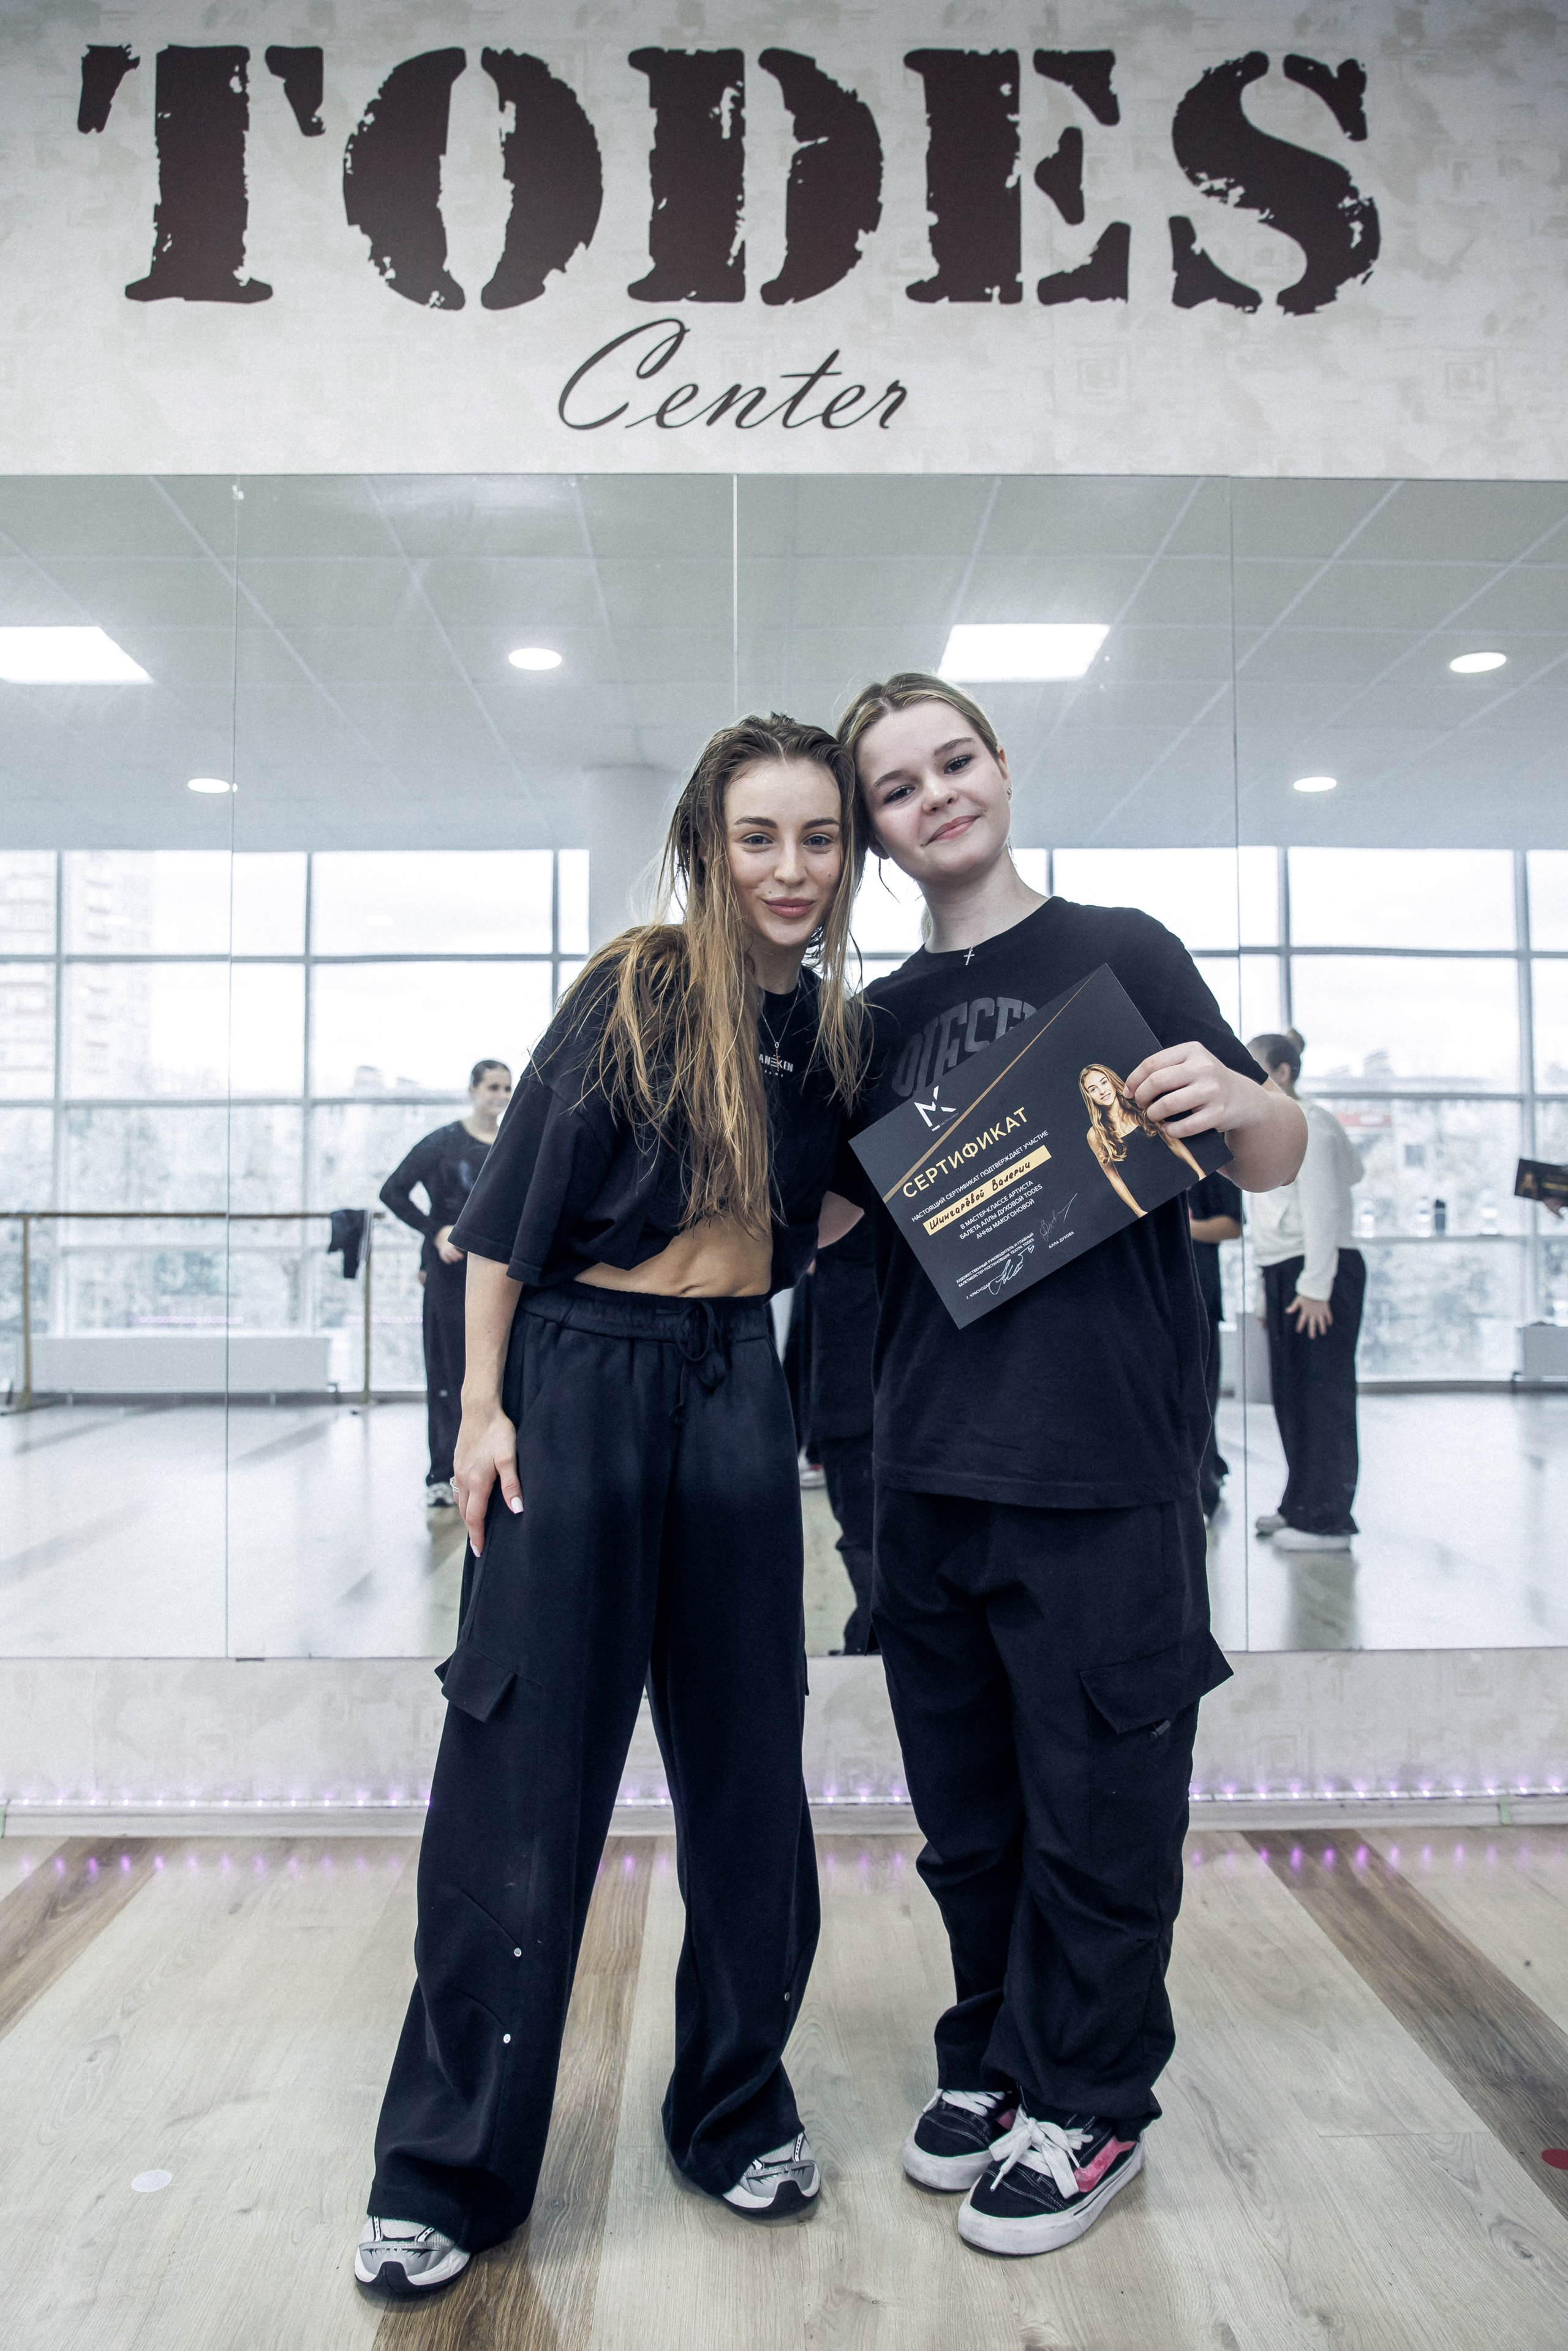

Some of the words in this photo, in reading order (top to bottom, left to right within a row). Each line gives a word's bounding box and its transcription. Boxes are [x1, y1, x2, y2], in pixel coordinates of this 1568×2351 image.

[77, 43, 1381, 315] TODES
[558, 318, 907, 430] Center
[903, 1107, 1027, 1197] СЕРТИФИКАТ
[911, 1197, 946, 1222] НАСТОЯЩИЙ
[946, 1175, 979, 1199] СЕРТИФИКАТ
[979, 1146, 1023, 1177] ПОДТВЕРЖДАЕТ
[1023, 1130, 1049, 1149] УЧАСТИЕ
[959, 1224, 981, 1239] БАЛЕТА
[981, 1213, 997, 1226] АЛЛЫ
[997, 1195, 1024, 1217] ДУХОВОЙ
[1023, 1184, 1042, 1198] TODES
[965, 1196, 1008, 1226] МАСТЕР-КЛАССЕ
[1009, 1180, 1033, 1199] АРТИСТА
[976, 1226, 993, 1239] АННЫ
[992, 1198, 1035, 1228] МАКОГОНОВОЙ
[956, 1261, 988, 1283] ХУДОЖЕСТВЕННЫЙ
[987, 1246, 1014, 1263] РУКОВОДИТЕЛЬ
[1017, 1232, 1034, 1245] ГЛАВНЫЙ
[958, 1253, 1010, 1287] БАЛЕТМЕЙСТЕР-ПОСТАНОВЩИК
[1010, 1245, 1023, 1254] ТЕАТРА
[1022, 1238, 1034, 1247] TODES
[1059, 1231, 1074, 1242] ДУХОВА
